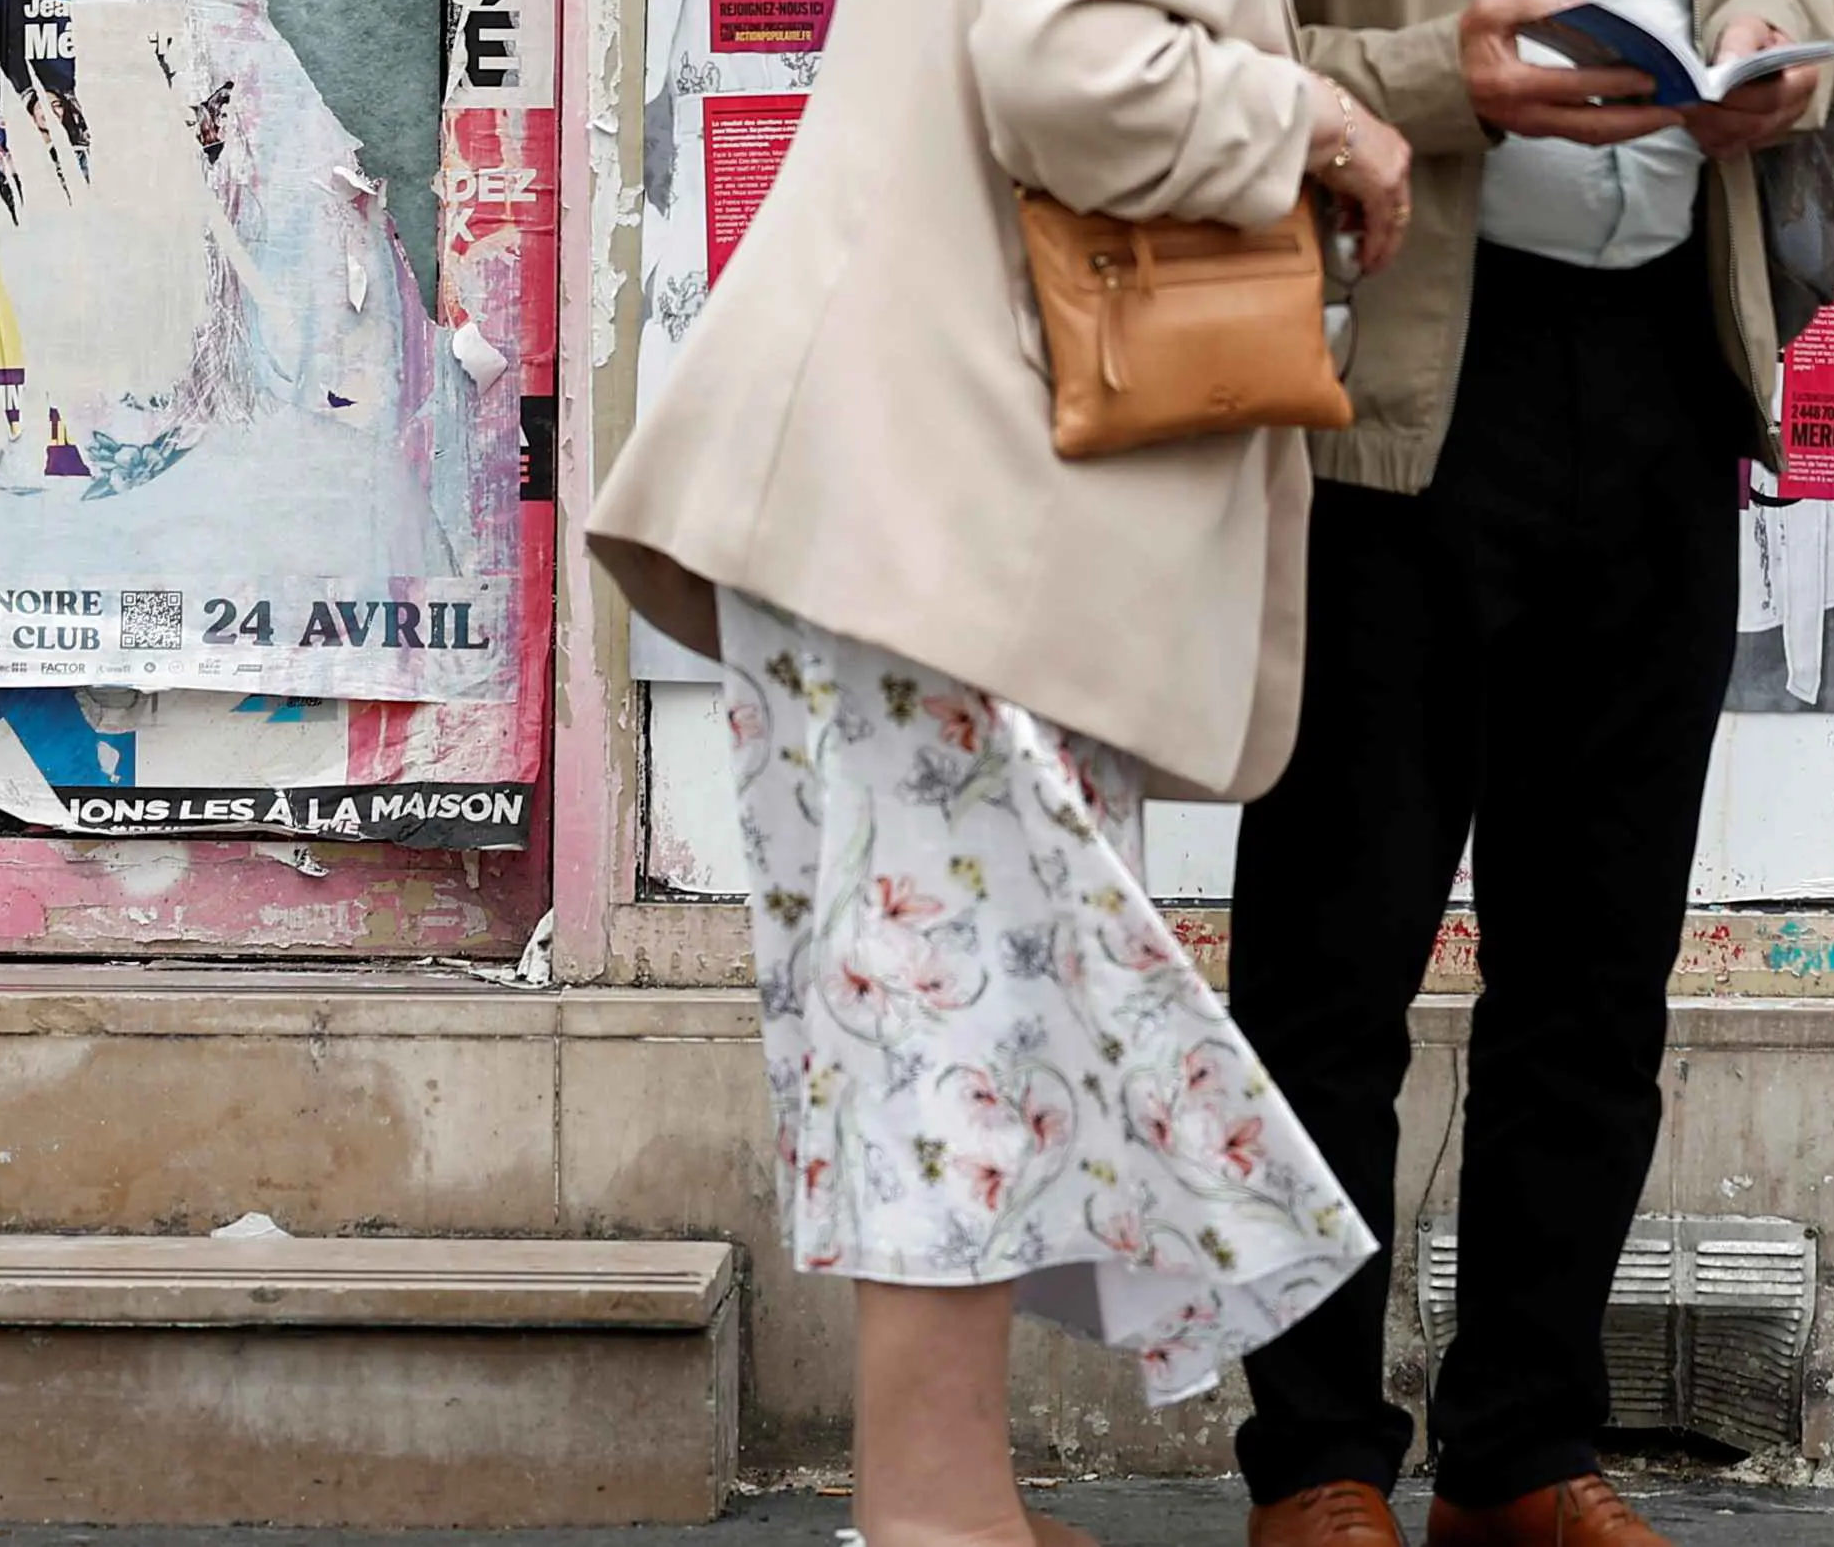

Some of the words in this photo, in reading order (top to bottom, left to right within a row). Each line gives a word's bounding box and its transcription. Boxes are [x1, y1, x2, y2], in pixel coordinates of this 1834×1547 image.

[13, 623, 101, 651] CLUB
[203, 599, 275, 648] 24
[300, 601, 490, 652] AVRIL
[179, 798, 255, 821] LES
[307, 798, 363, 831] LA
[370, 789, 523, 825] MAISON
